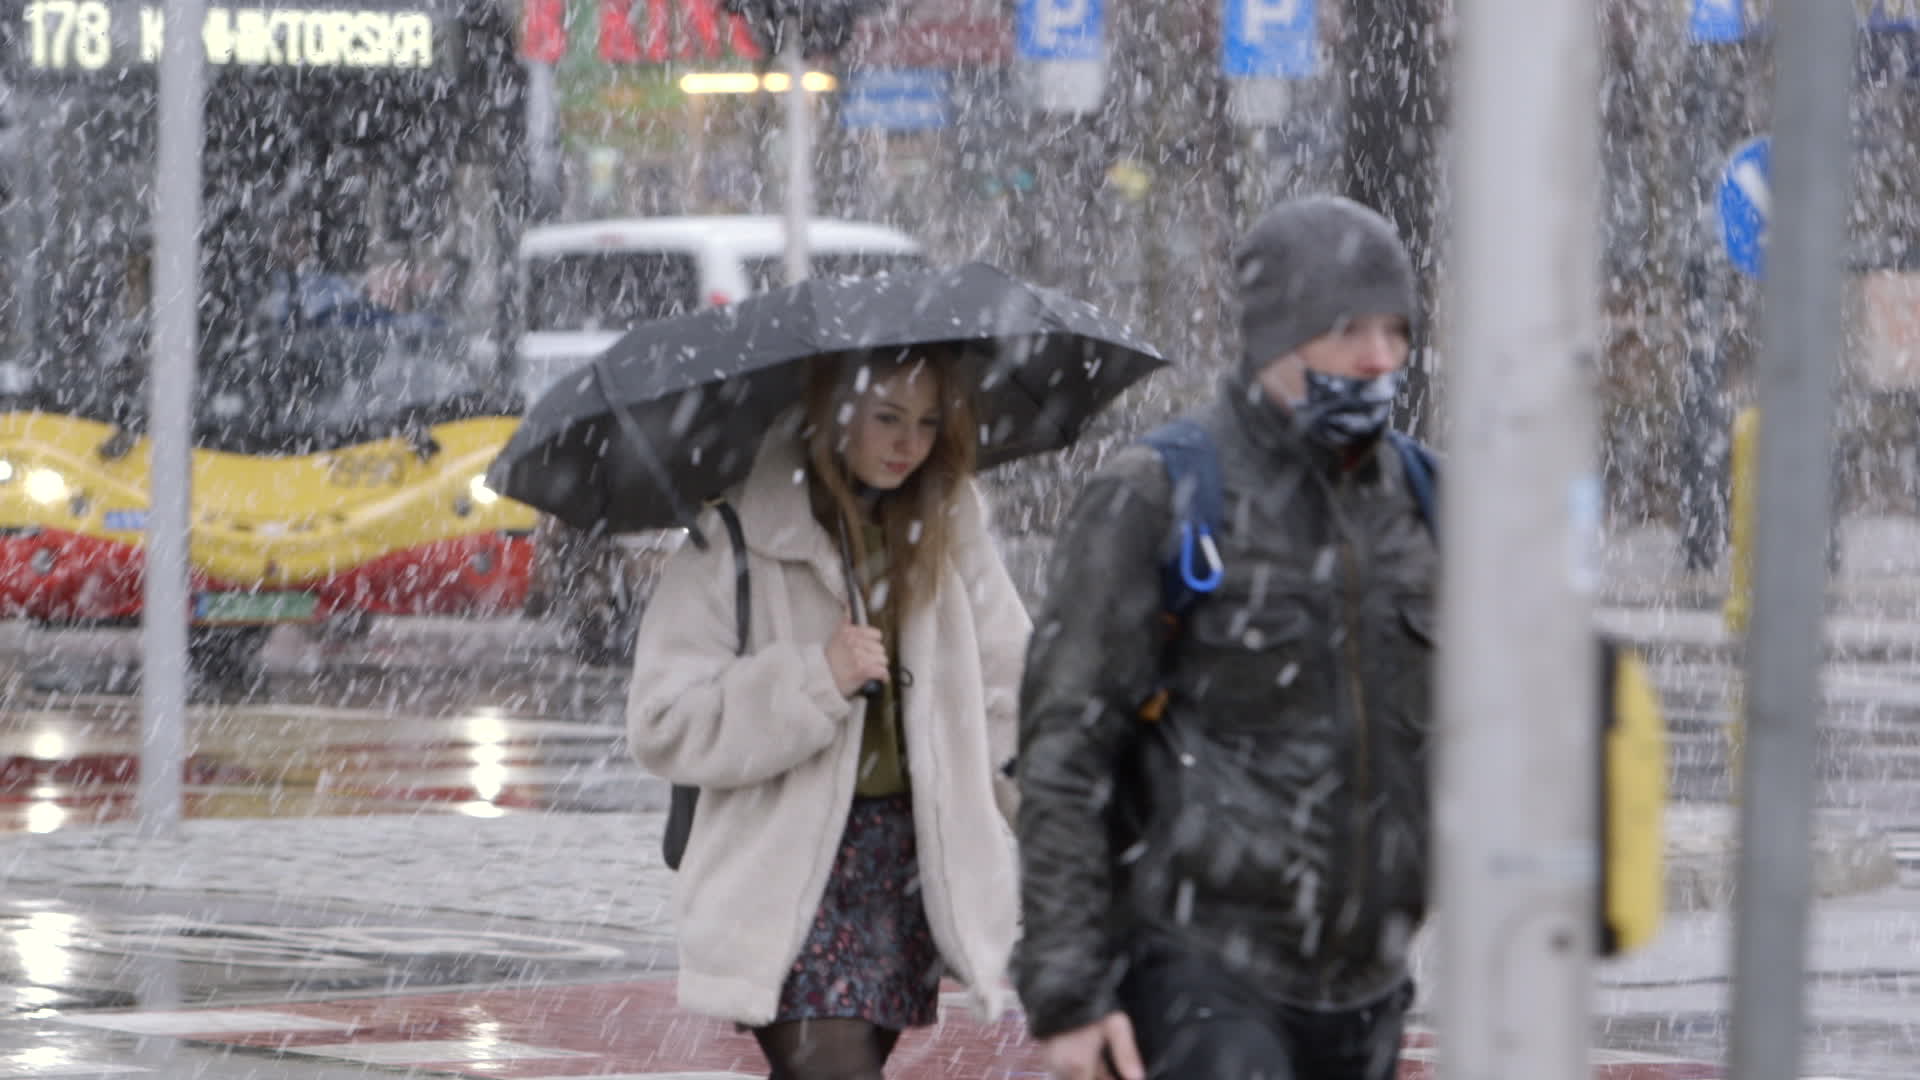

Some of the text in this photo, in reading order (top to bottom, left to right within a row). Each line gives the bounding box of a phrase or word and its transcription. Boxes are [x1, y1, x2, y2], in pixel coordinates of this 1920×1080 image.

[23, 0, 111, 69] 178
[1035, 0, 1087, 48] P
[1243, 0, 1298, 42] P
